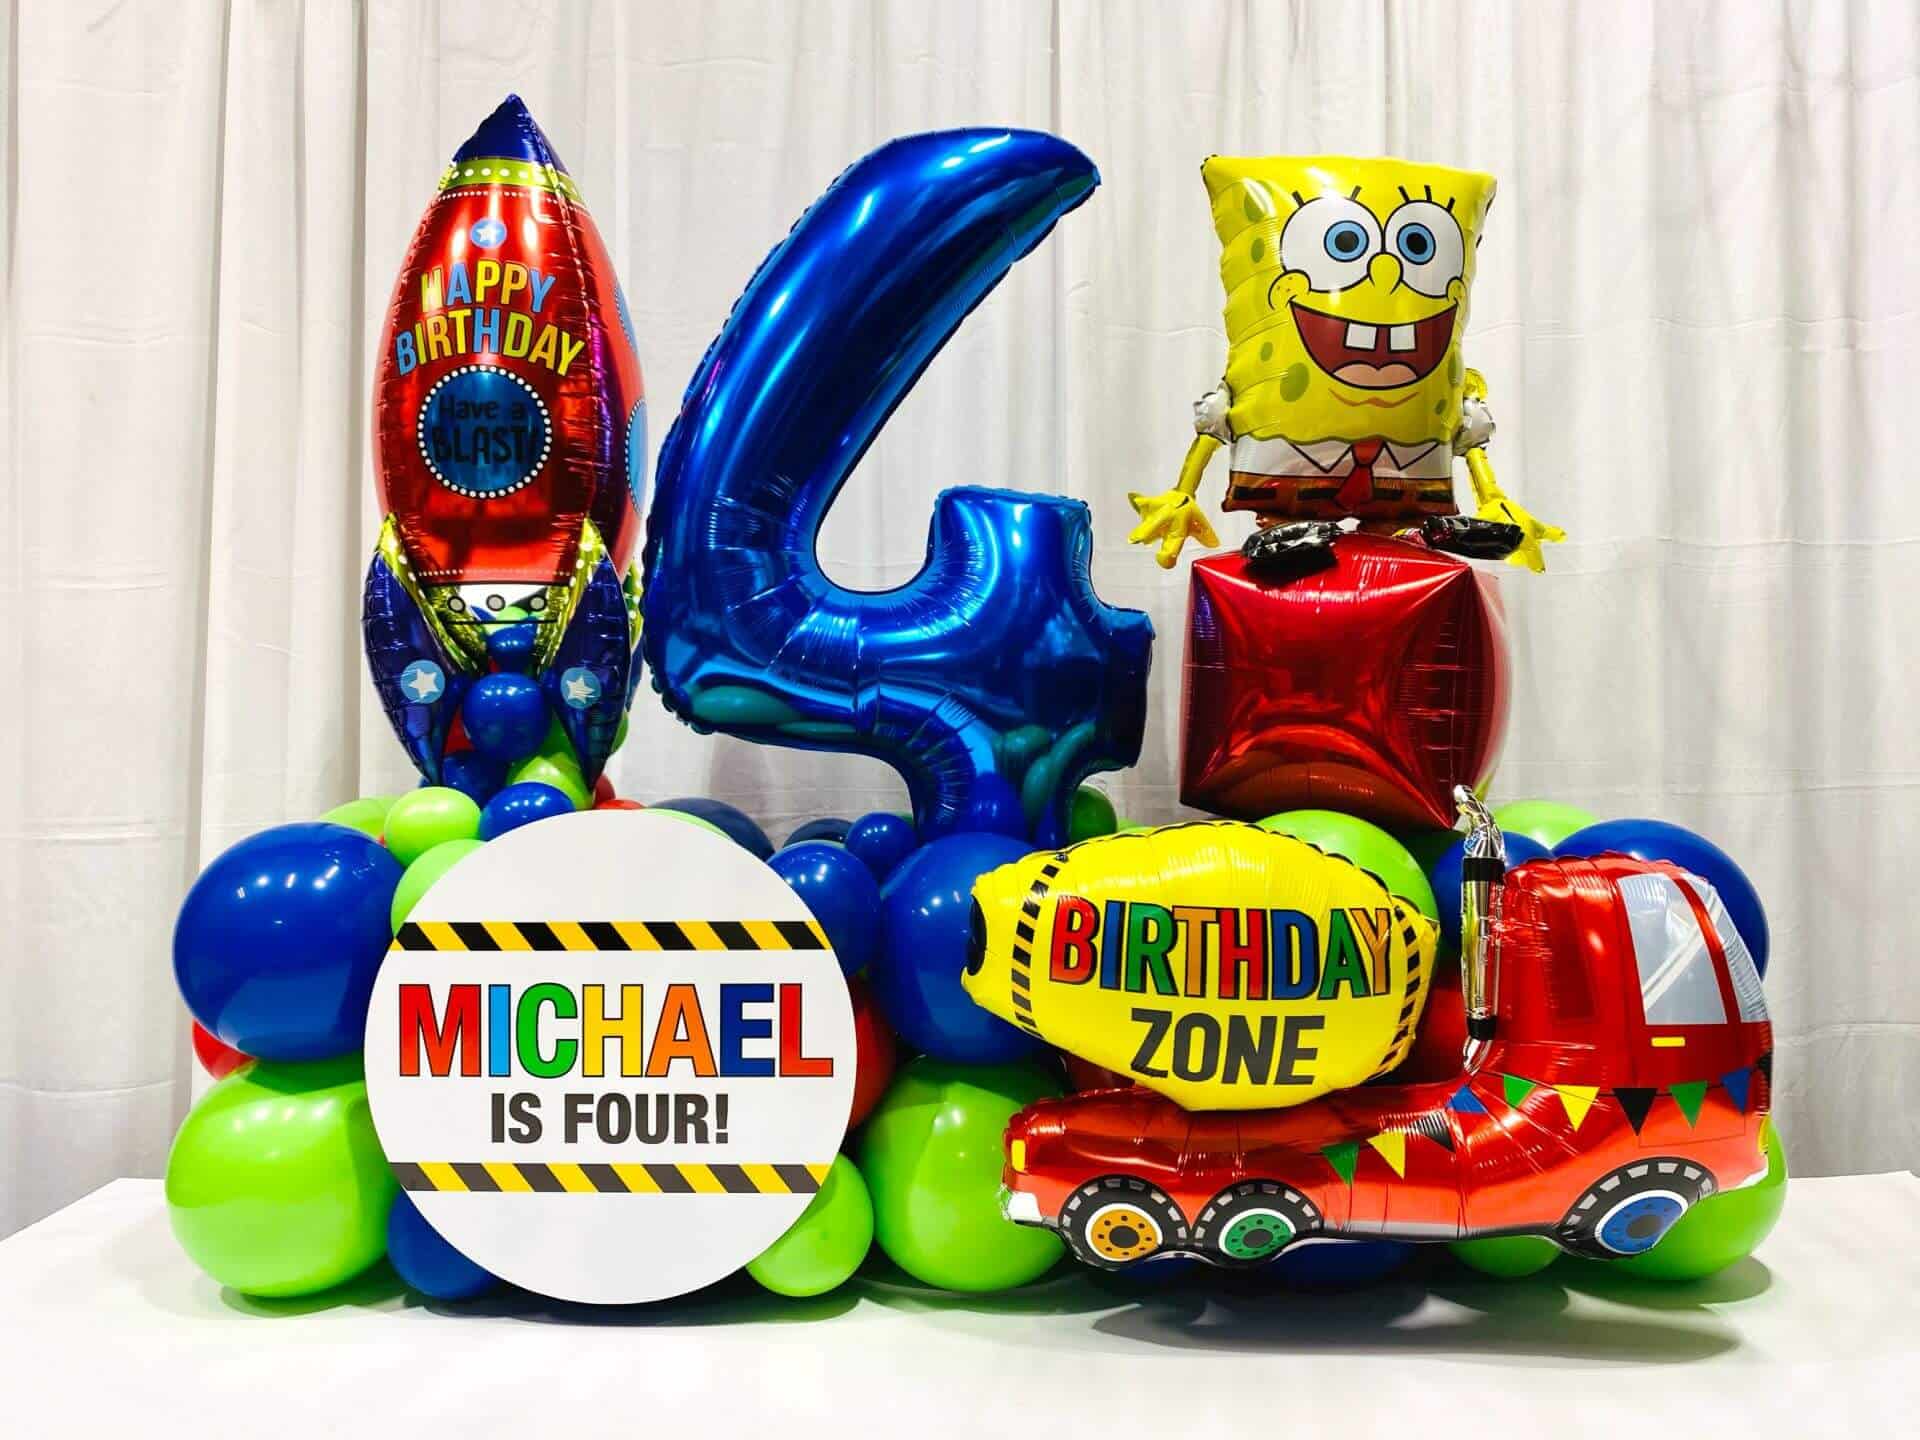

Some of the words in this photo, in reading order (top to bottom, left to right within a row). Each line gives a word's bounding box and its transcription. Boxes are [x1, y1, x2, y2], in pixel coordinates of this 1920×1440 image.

[421, 259, 556, 313] HAPPY
[394, 307, 585, 377] BIRTHDAY
[439, 395, 498, 420] Have
[510, 400, 526, 420] a
[1048, 895, 1393, 1001] BIRTHDAY
[399, 982, 834, 1079] MICHAEL
[1130, 1008, 1325, 1085] ZONE
[491, 1093, 543, 1144] IS
[564, 1093, 729, 1144] FOUR!
